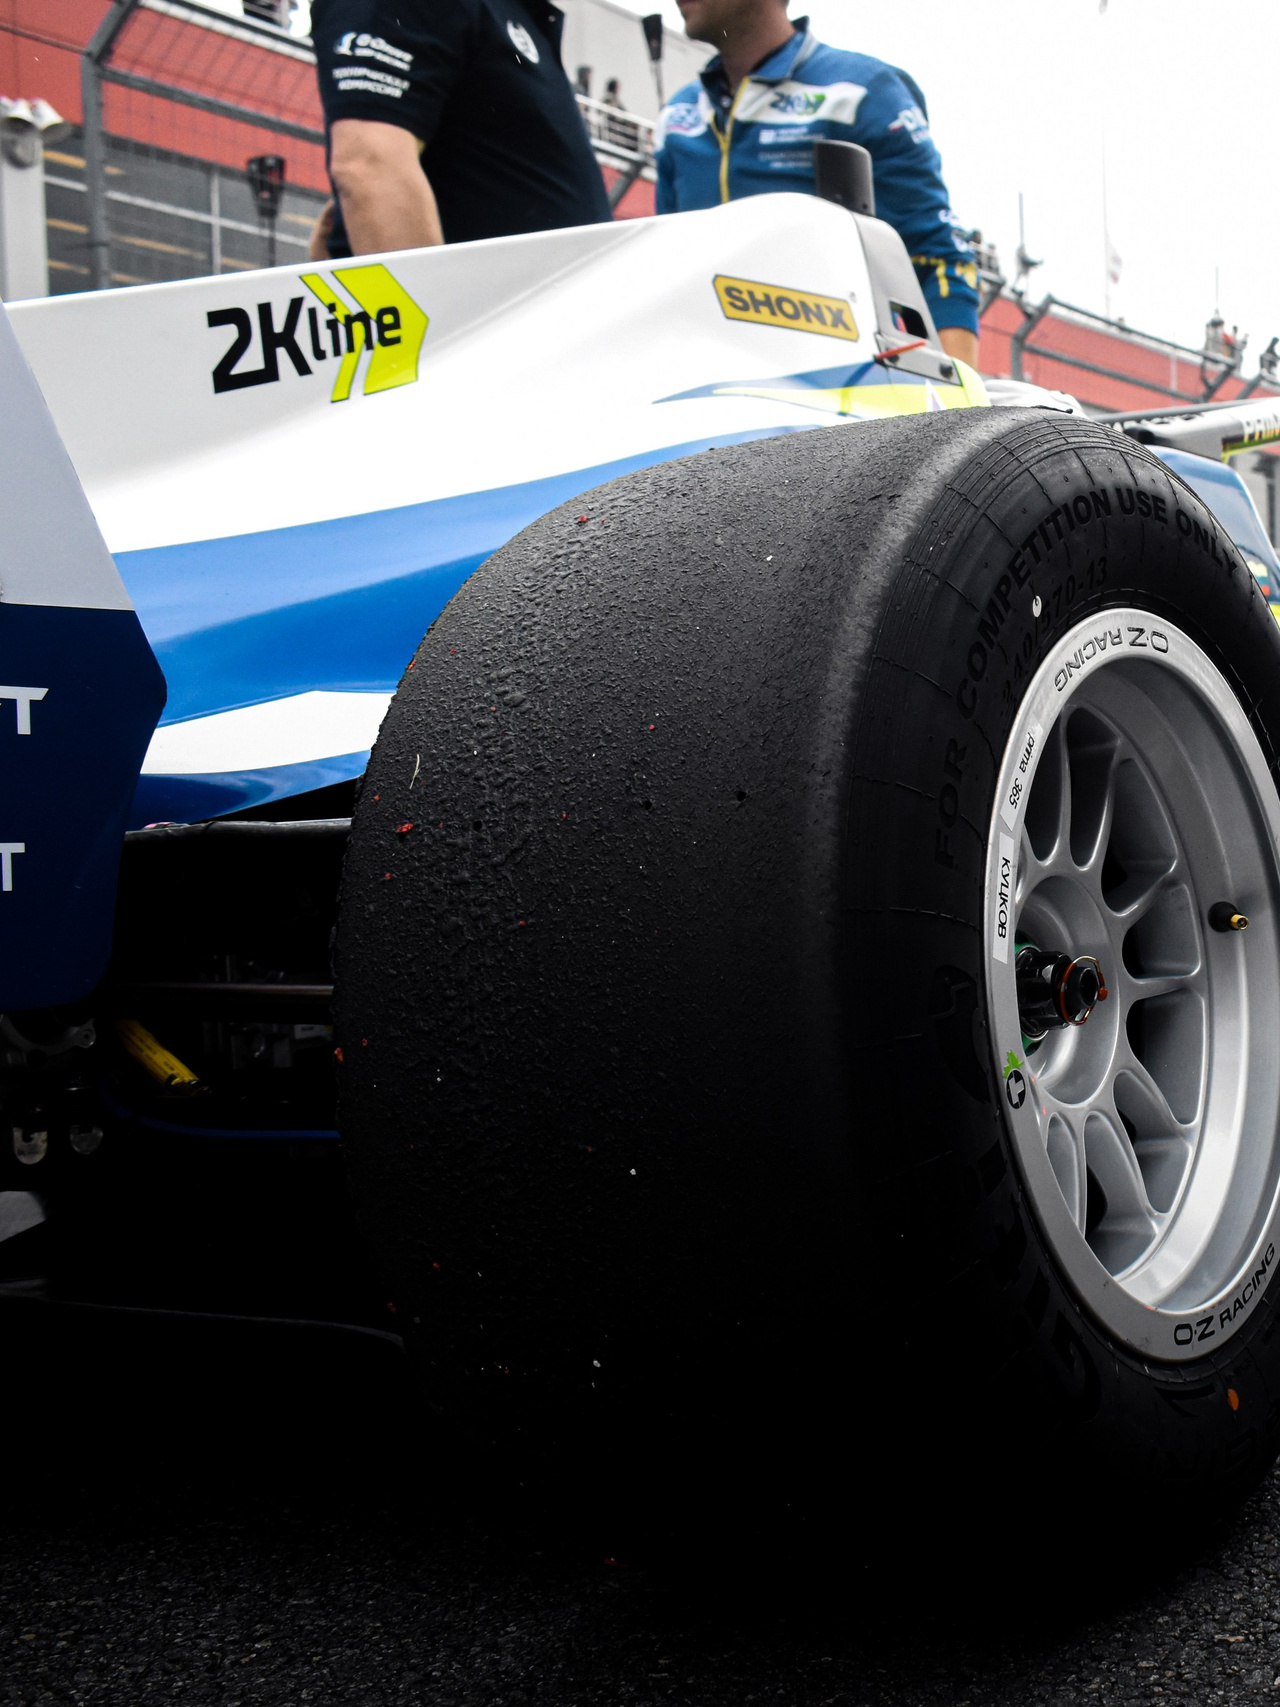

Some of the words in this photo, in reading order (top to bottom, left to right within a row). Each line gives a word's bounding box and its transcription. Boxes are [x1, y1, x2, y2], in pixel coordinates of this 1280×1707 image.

[206, 297, 402, 394] 2Kline
[724, 286, 852, 331] SHONX
[934, 738, 969, 871] FOR
[956, 489, 1112, 719] COMPETITION
[1116, 488, 1168, 525] USE
[1175, 508, 1238, 580] ONLY
[1053, 626, 1123, 693] RACING
[1017, 730, 1036, 774] prima
[1008, 777, 1024, 810] 365
[998, 856, 1014, 940] КУЦКОВ
[1218, 1241, 1276, 1329] RACING
